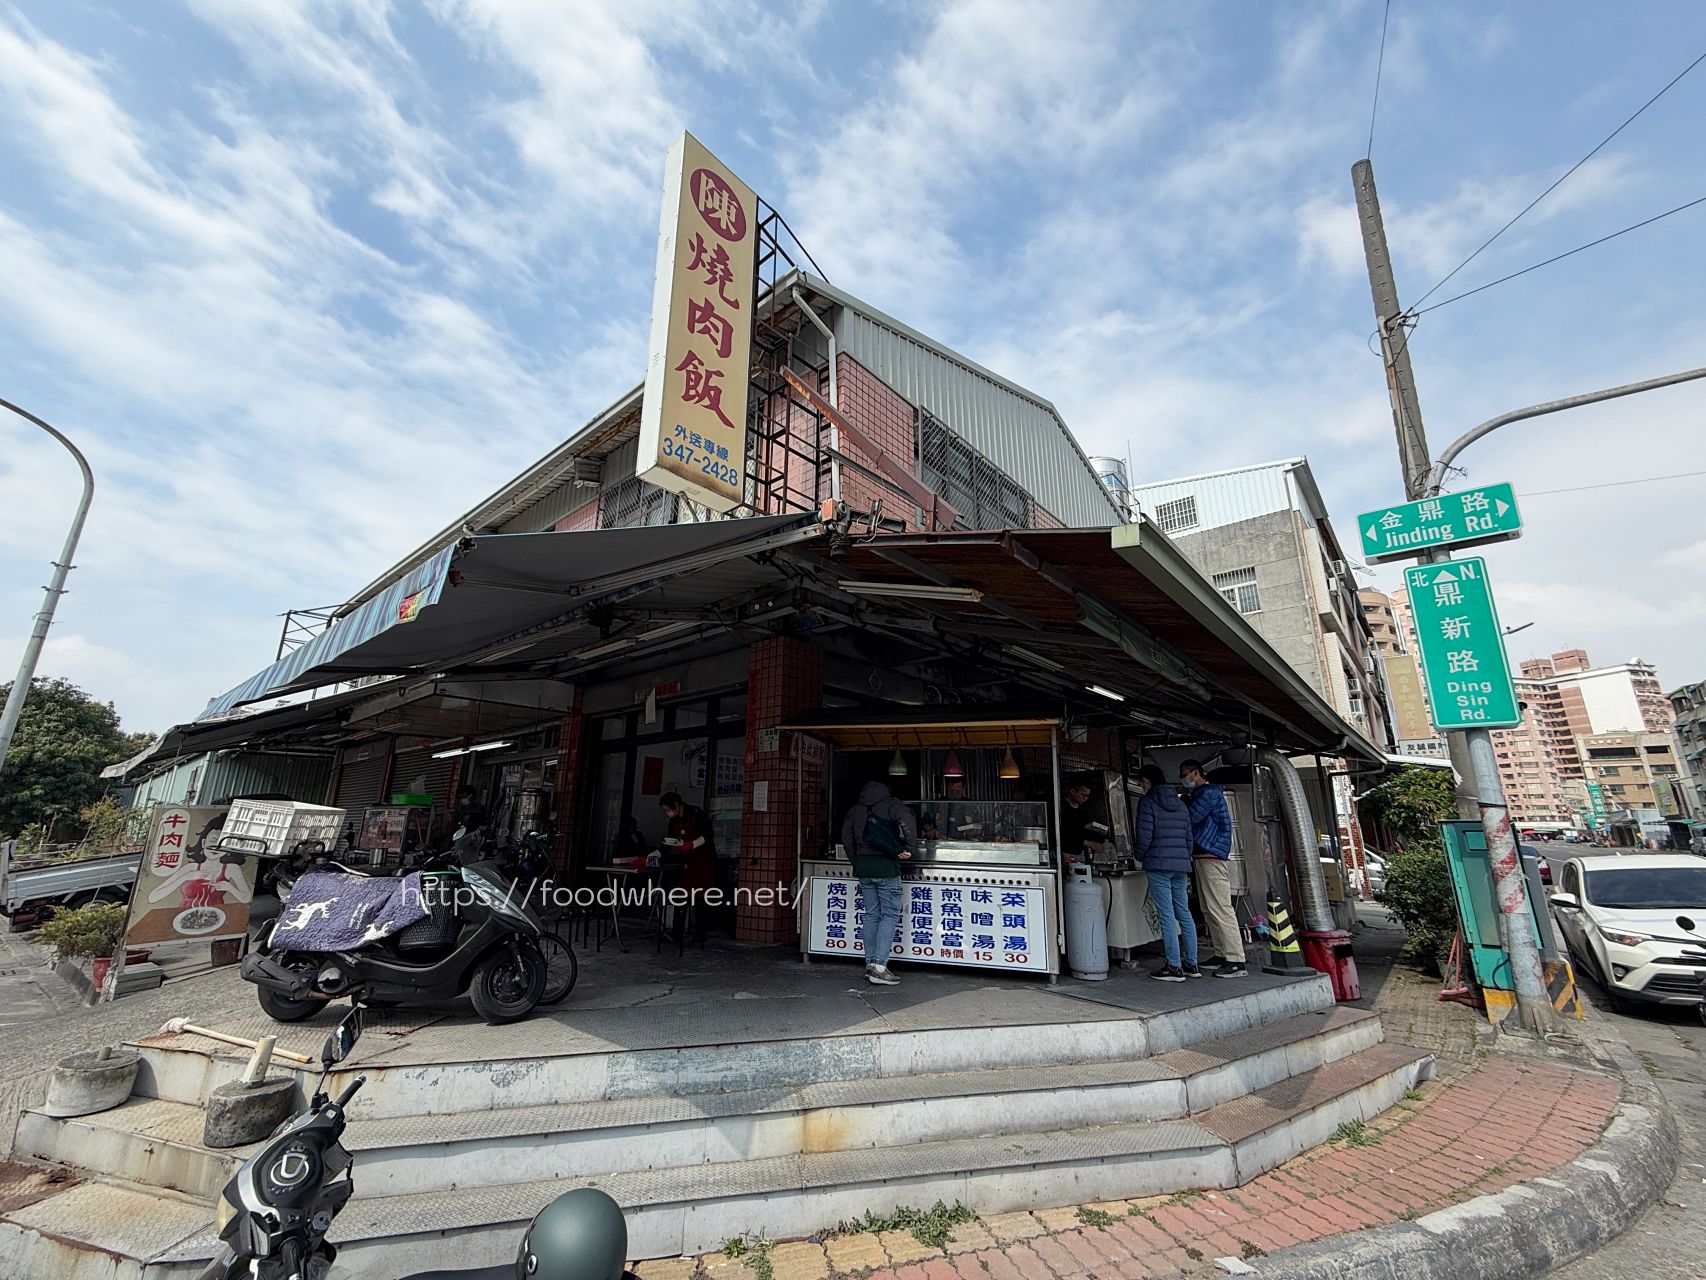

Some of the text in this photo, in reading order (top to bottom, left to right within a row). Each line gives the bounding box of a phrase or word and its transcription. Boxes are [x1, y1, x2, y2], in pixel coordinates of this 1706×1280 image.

[675, 232, 740, 429] 燒肉飯
[663, 437, 738, 486] 347-2428
[1379, 491, 1491, 530] 金鼎路
[1385, 513, 1498, 549] Jinding Rd.
[1411, 571, 1429, 588] 北
[1434, 582, 1480, 674] 鼎新路
[1447, 681, 1492, 694] Ding
[1457, 694, 1489, 707] Sin
[1460, 708, 1491, 721] Rd.
[155, 813, 187, 868] 牛肉麵
[911, 886, 933, 945] 雞腿便當
[940, 888, 963, 947] 煎魚便當
[970, 890, 995, 949] 味噌湯
[1001, 892, 1028, 951] 菜頭湯
[825, 939, 847, 949] 80
[911, 946, 935, 956] 90
[940, 948, 964, 959] 時價
[973, 950, 993, 961] 15
[1004, 952, 1028, 963] 30
